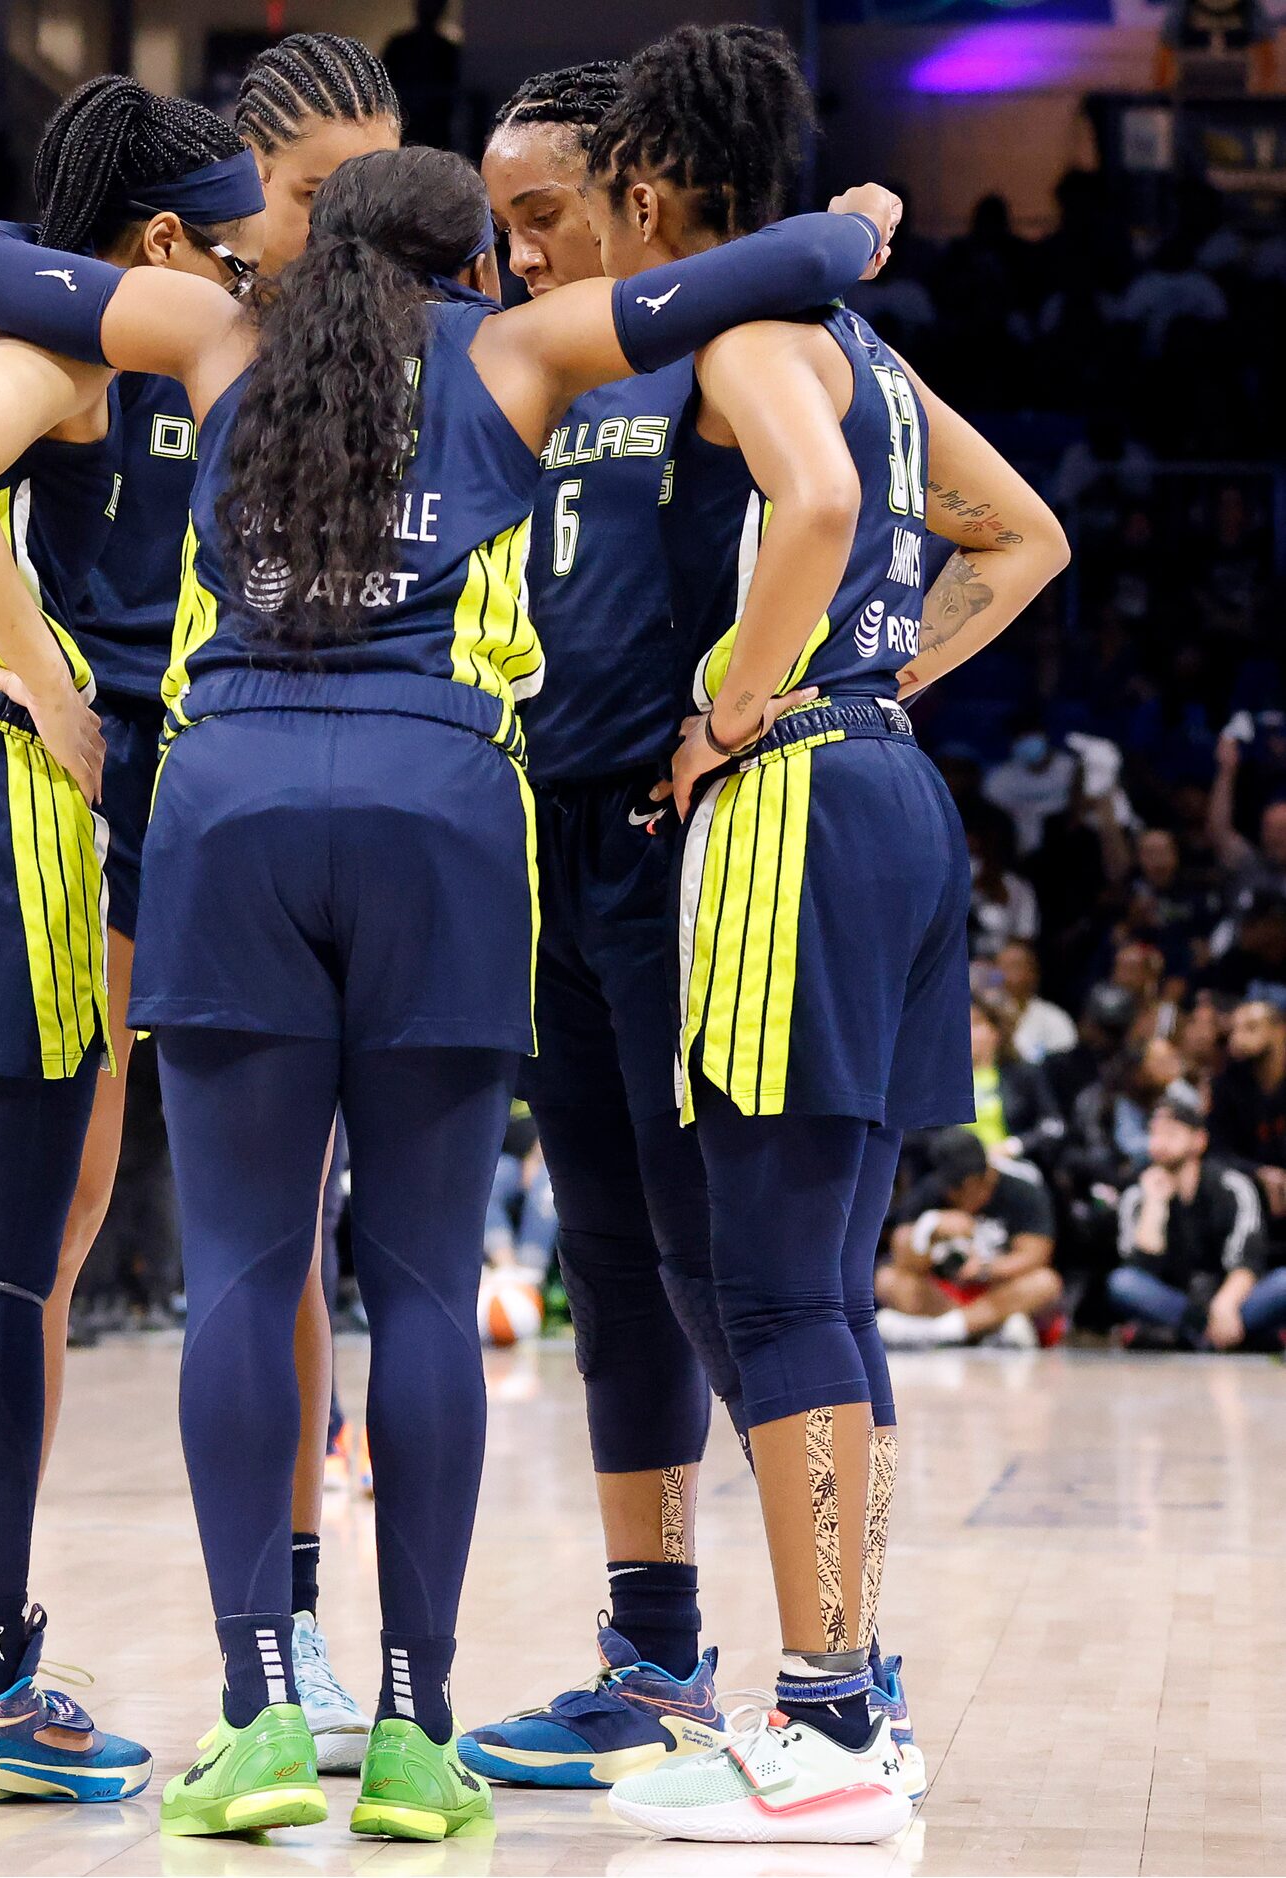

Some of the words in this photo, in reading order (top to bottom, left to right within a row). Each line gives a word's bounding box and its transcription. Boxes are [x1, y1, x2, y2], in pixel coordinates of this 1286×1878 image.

[539, 415, 670, 470] ALLAS
[552, 478, 583, 577] 6
[886, 526, 922, 589] HARRIS
[304, 569, 420, 608] AT&T
[886, 615, 921, 657] AT&T
